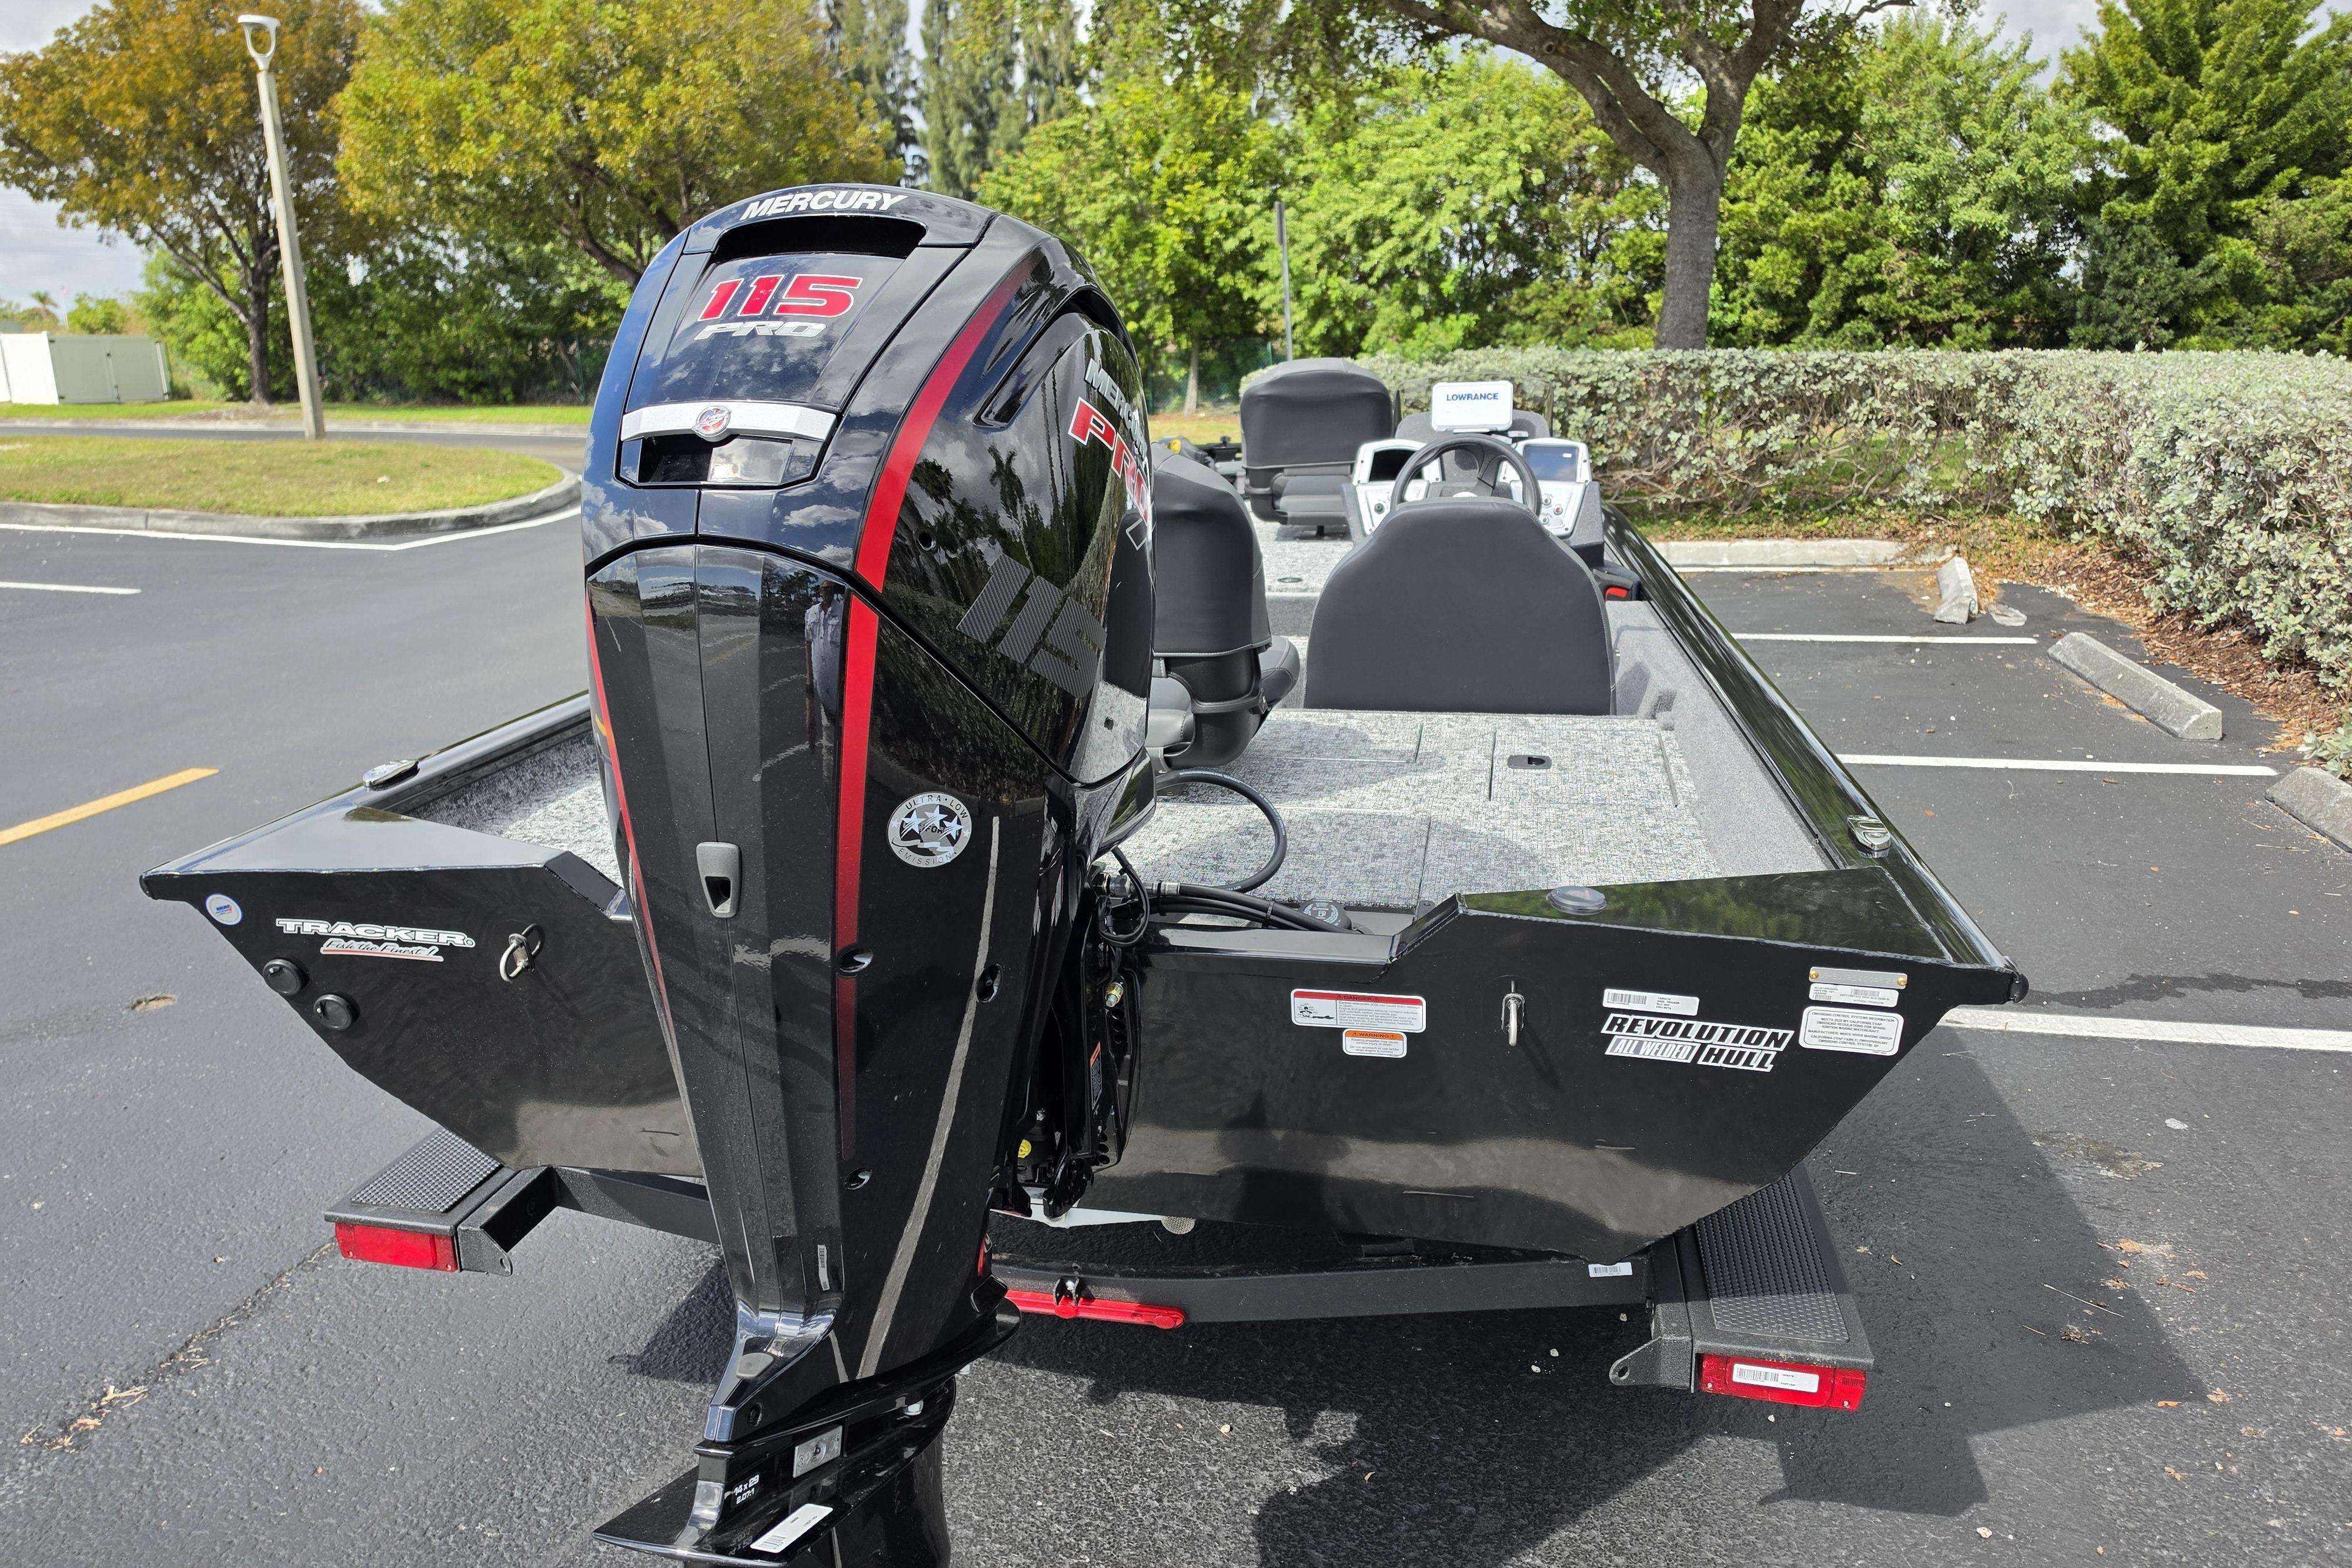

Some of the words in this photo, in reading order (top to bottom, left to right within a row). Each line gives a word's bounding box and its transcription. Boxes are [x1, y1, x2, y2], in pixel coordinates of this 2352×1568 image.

[739, 191, 908, 221] MERCURY
[697, 274, 864, 322] 115
[694, 320, 827, 340] PRO
[1446, 392, 1499, 402] LOWRANCE
[1068, 396, 1150, 526] PRO
[957, 554, 1107, 698] 115
[906, 795, 941, 810] ULTRA
[949, 800, 968, 818] LOW
[898, 847, 952, 865] EMISSION
[276, 919, 470, 946] TRACKER
[326, 941, 356, 950] Fish
[357, 942, 378, 951] the
[1602, 1014, 1793, 1051] REVOLUTION
[1614, 1039, 1635, 1055] ALL
[1639, 1041, 1693, 1060] WELDED
[1700, 1046, 1775, 1071] HULL
[734, 1485, 743, 1496] 14
[743, 1483, 748, 1491] x
[749, 1474, 760, 1487] 29
